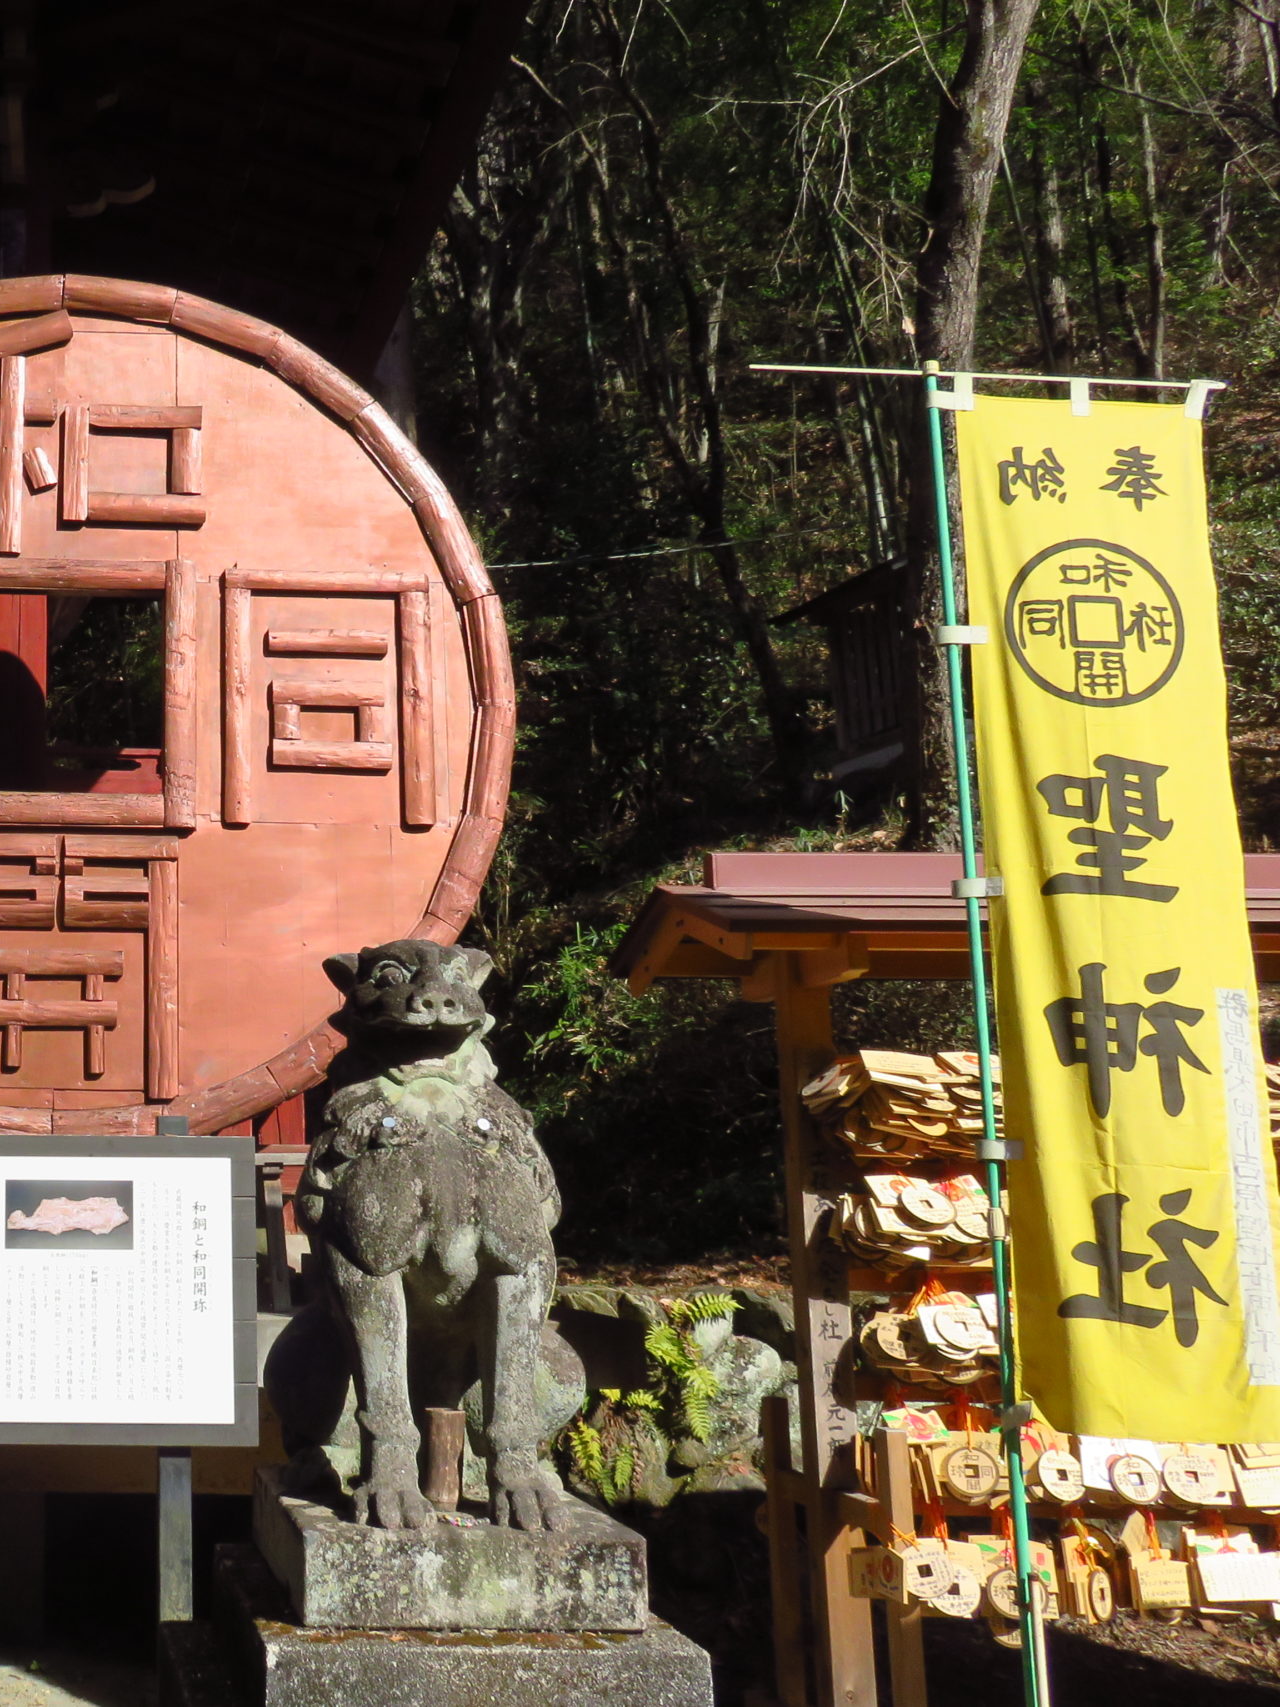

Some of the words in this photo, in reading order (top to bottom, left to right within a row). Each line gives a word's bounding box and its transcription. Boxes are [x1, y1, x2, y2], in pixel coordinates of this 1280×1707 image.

[224, 565, 436, 826] 同
[192, 1200, 208, 1313] 和銅と和同開珎
